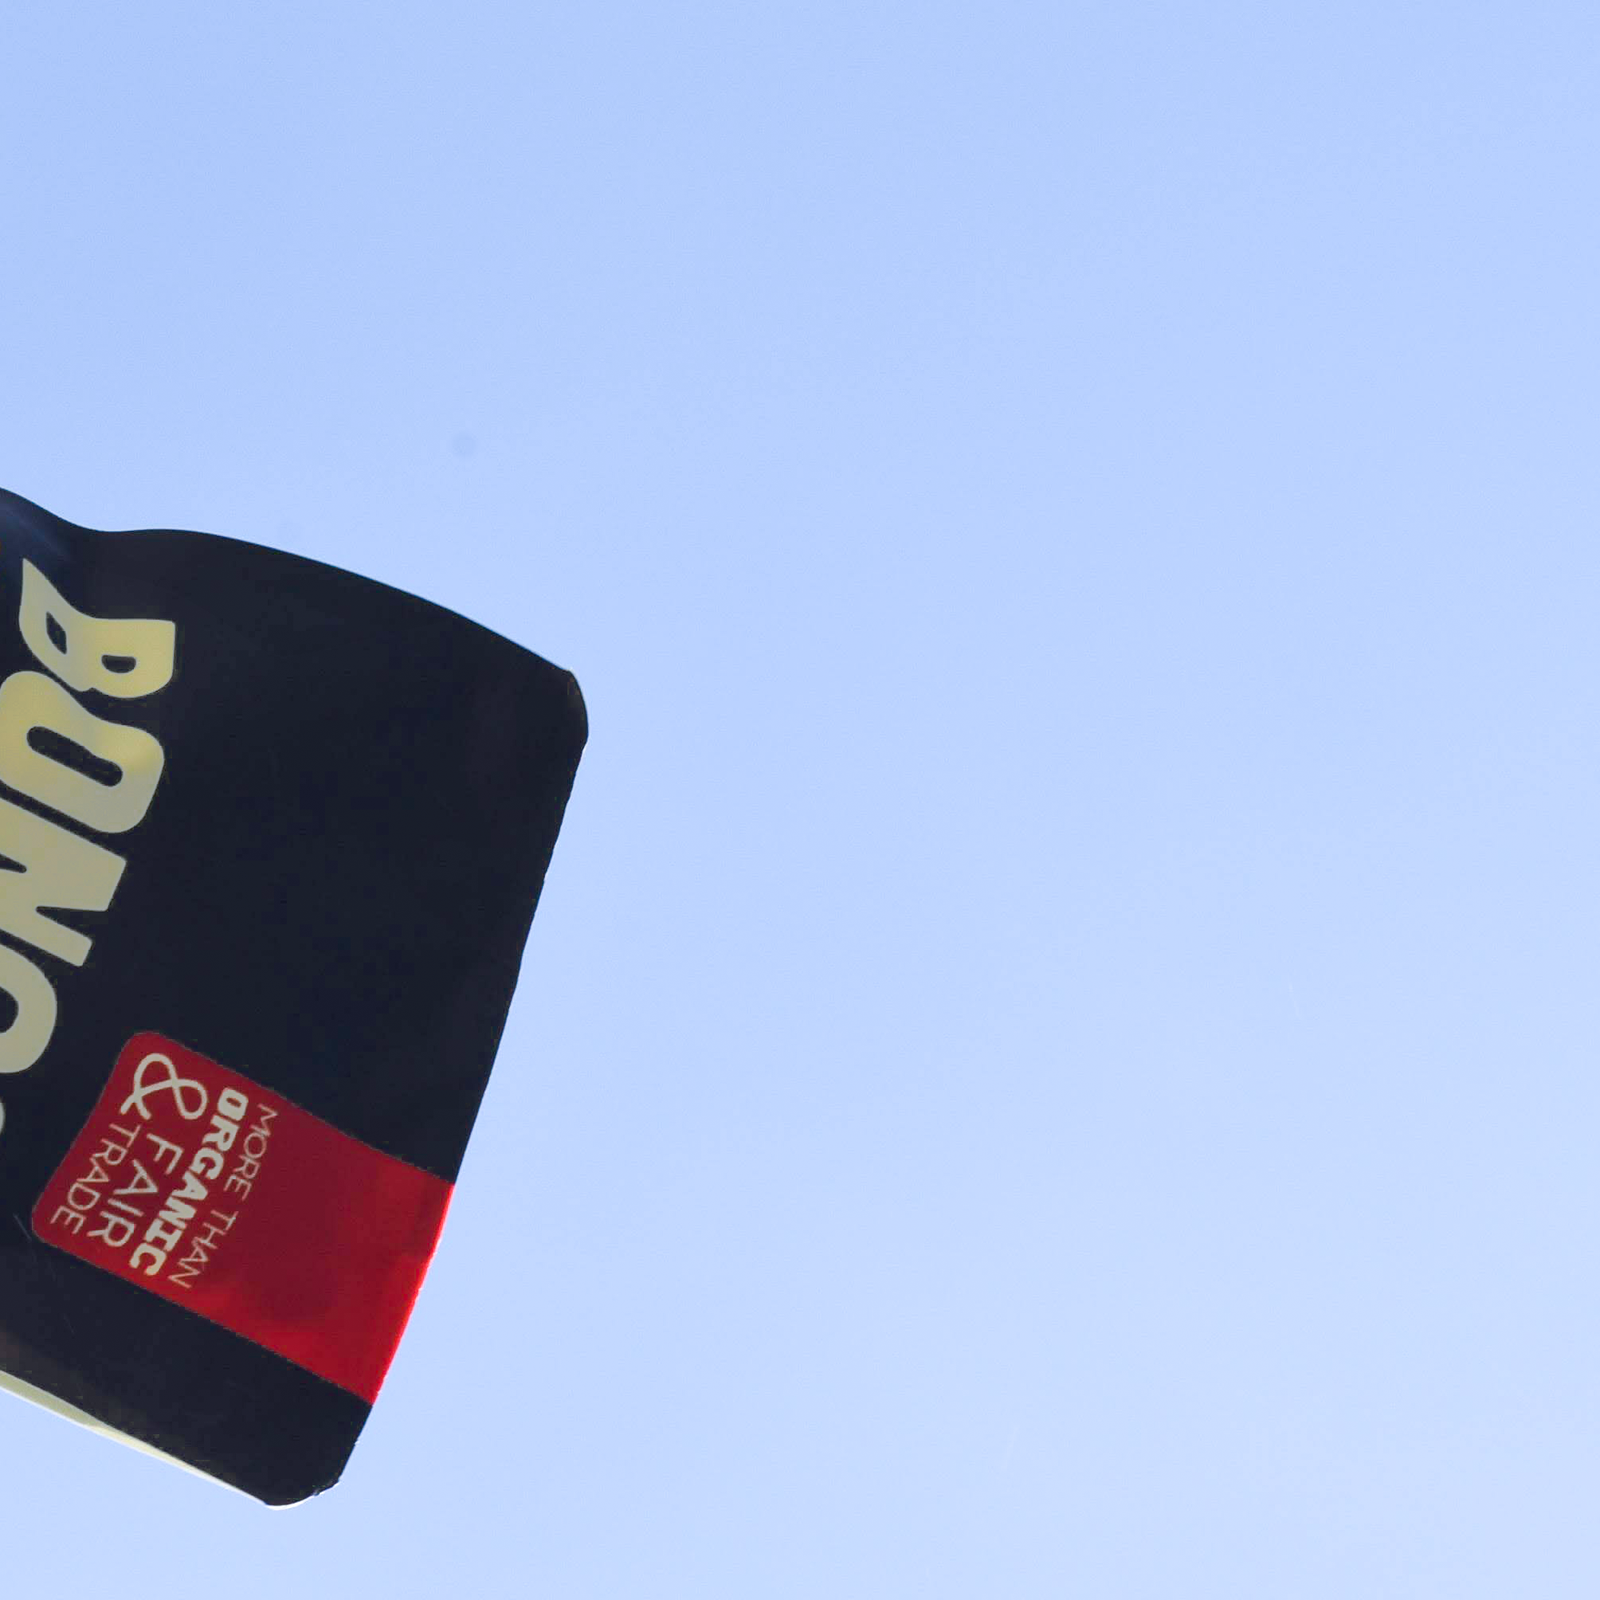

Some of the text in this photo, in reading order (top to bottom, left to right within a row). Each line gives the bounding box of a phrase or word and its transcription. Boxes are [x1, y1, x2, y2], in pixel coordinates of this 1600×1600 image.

[50, 1123, 142, 1235] TRADE
[86, 1133, 184, 1247] FAIR
[129, 1087, 249, 1276] ORGANIC
[168, 1103, 278, 1288] MORE THAN
